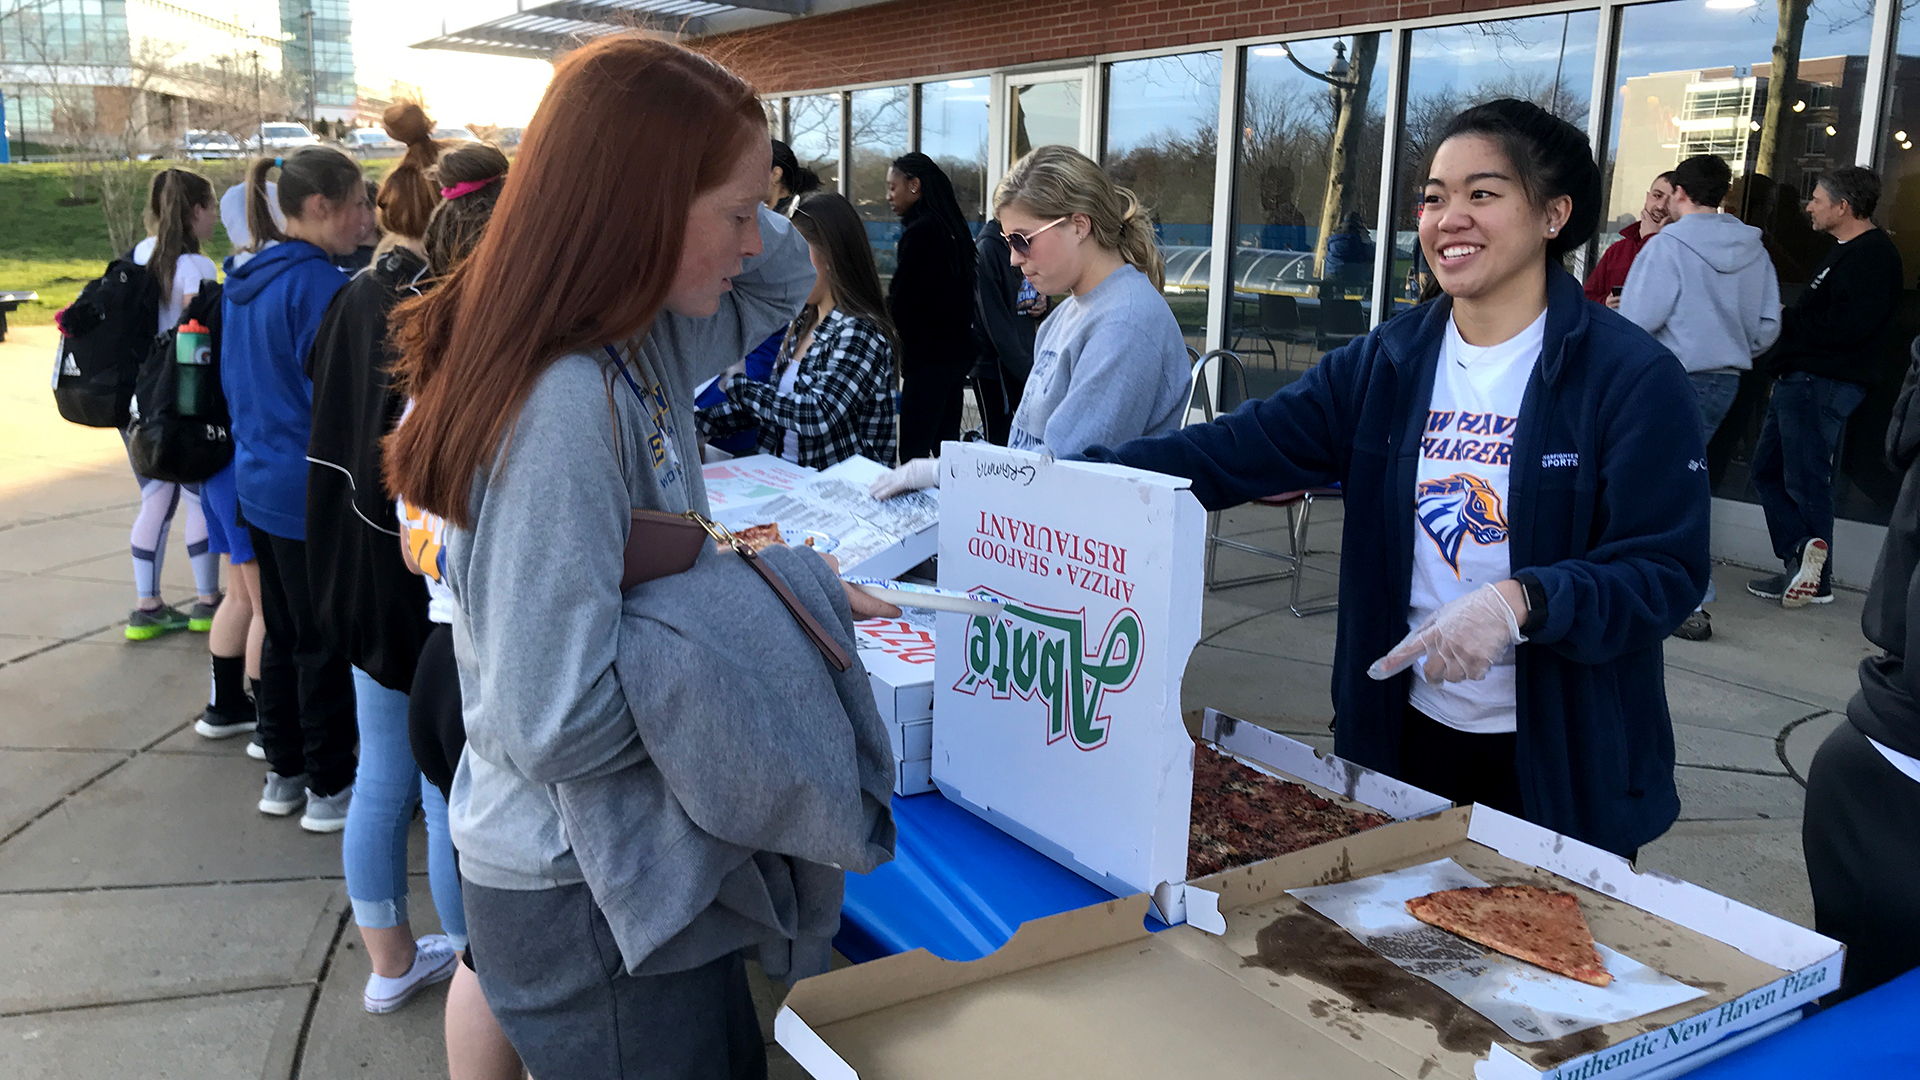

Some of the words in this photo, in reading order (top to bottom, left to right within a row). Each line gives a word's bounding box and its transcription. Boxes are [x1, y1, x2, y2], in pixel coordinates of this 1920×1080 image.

[1457, 411, 1517, 439] HAV
[1541, 459, 1579, 468] SPORTS
[968, 537, 1050, 577] SEAFOOD
[976, 510, 1128, 575] RESTAURANT
[1066, 563, 1136, 603] APIZZA
[1662, 1016, 1713, 1050] New
[1716, 988, 1777, 1028] Haven
[1780, 966, 1828, 999] Pizza
